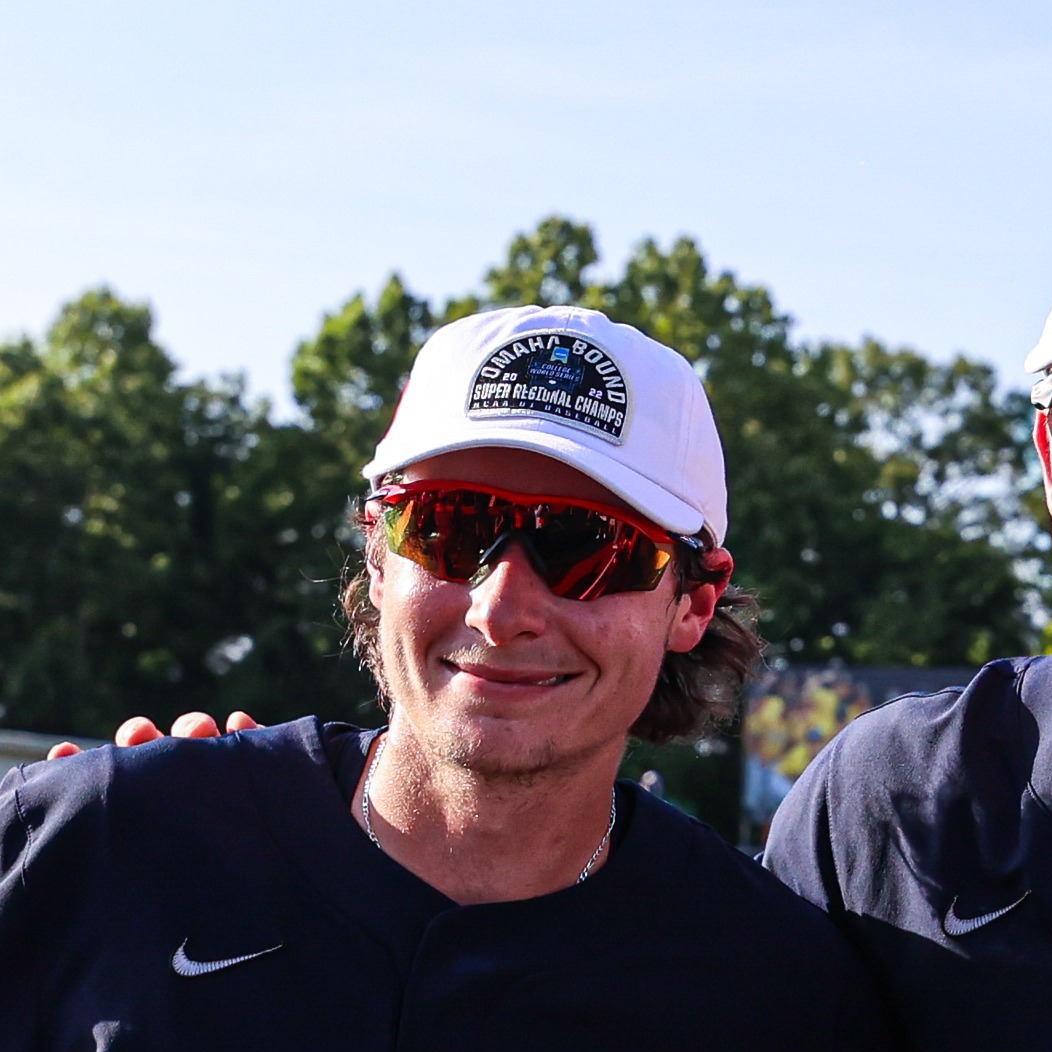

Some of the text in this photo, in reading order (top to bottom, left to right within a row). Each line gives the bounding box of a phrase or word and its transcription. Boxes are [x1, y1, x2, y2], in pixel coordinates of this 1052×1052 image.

[481, 336, 626, 405] OMAHA BOUND
[502, 372, 603, 398] 20 22
[473, 383, 624, 428] SUPER REGIONAL CHAMPS
